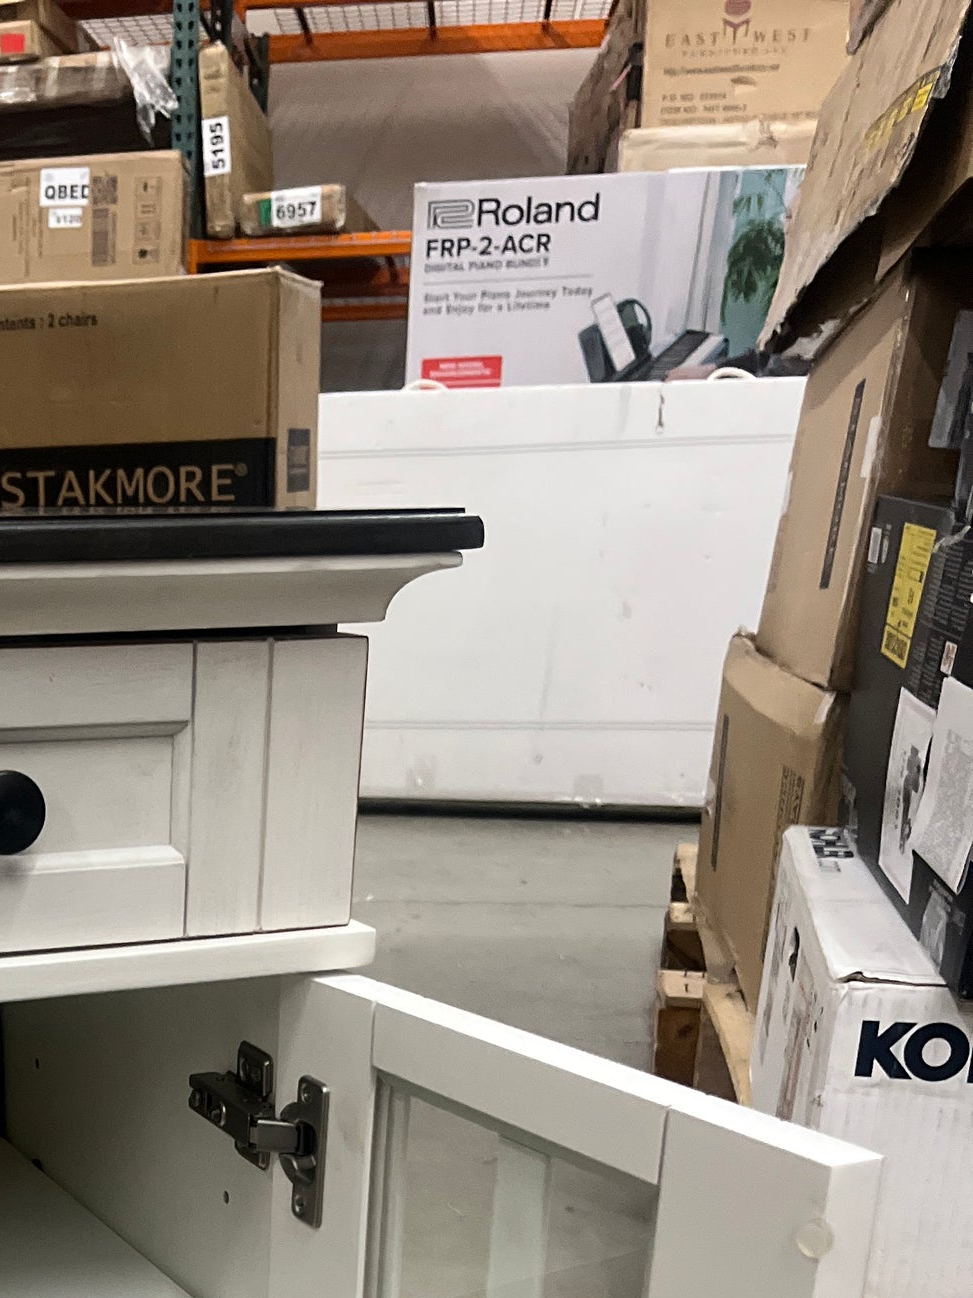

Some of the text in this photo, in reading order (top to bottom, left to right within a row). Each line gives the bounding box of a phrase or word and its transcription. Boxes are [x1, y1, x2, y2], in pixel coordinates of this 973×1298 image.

[664, 27, 812, 48] EAST WEST
[209, 122, 226, 169] 5195
[276, 201, 317, 220] 6957
[477, 192, 601, 227] Roland
[426, 233, 551, 259] FRP-2-ACR
[47, 313, 55, 329] 2
[58, 312, 99, 328] chairs
[854, 1019, 973, 1083] KO
